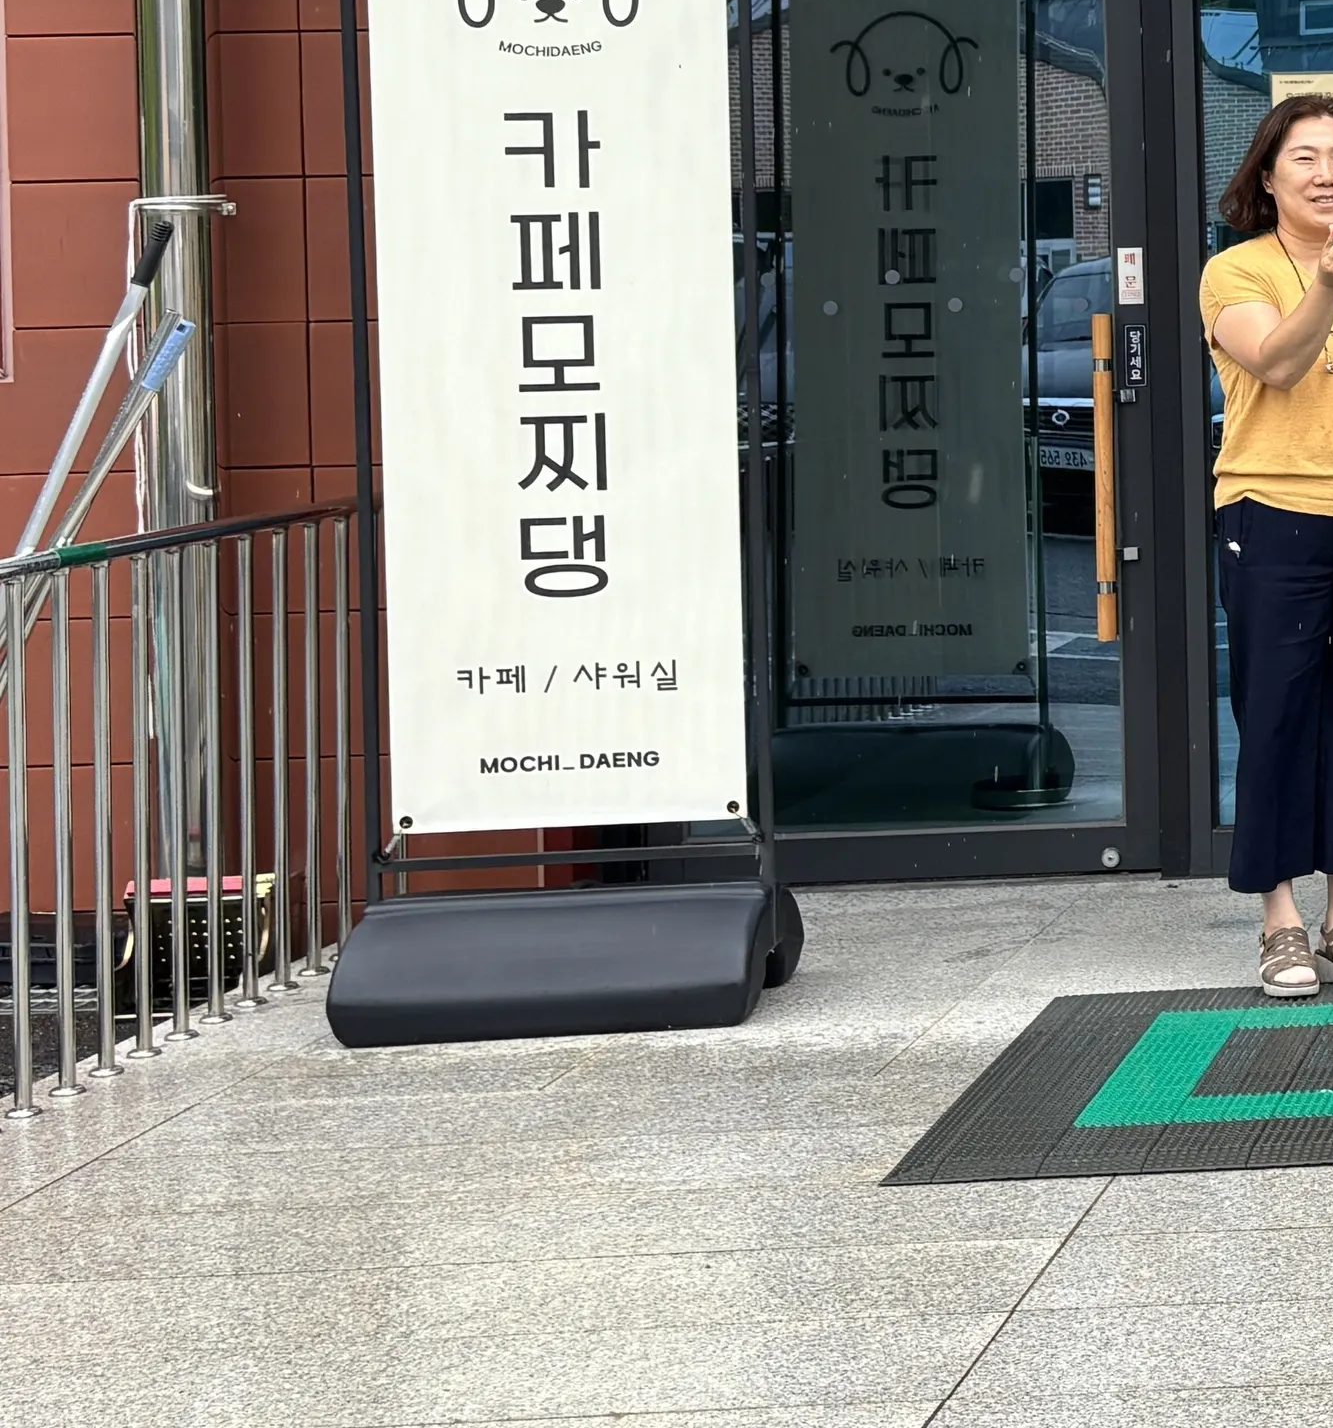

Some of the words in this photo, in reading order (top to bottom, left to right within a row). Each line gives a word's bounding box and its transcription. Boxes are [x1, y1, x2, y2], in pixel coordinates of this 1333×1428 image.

[498, 40, 603, 58] MOCHIDAENG
[502, 108, 609, 598] 카페모찌댕
[1130, 330, 1143, 380] 당기세요
[456, 666, 527, 695] 카페
[573, 658, 680, 692] 샤워실
